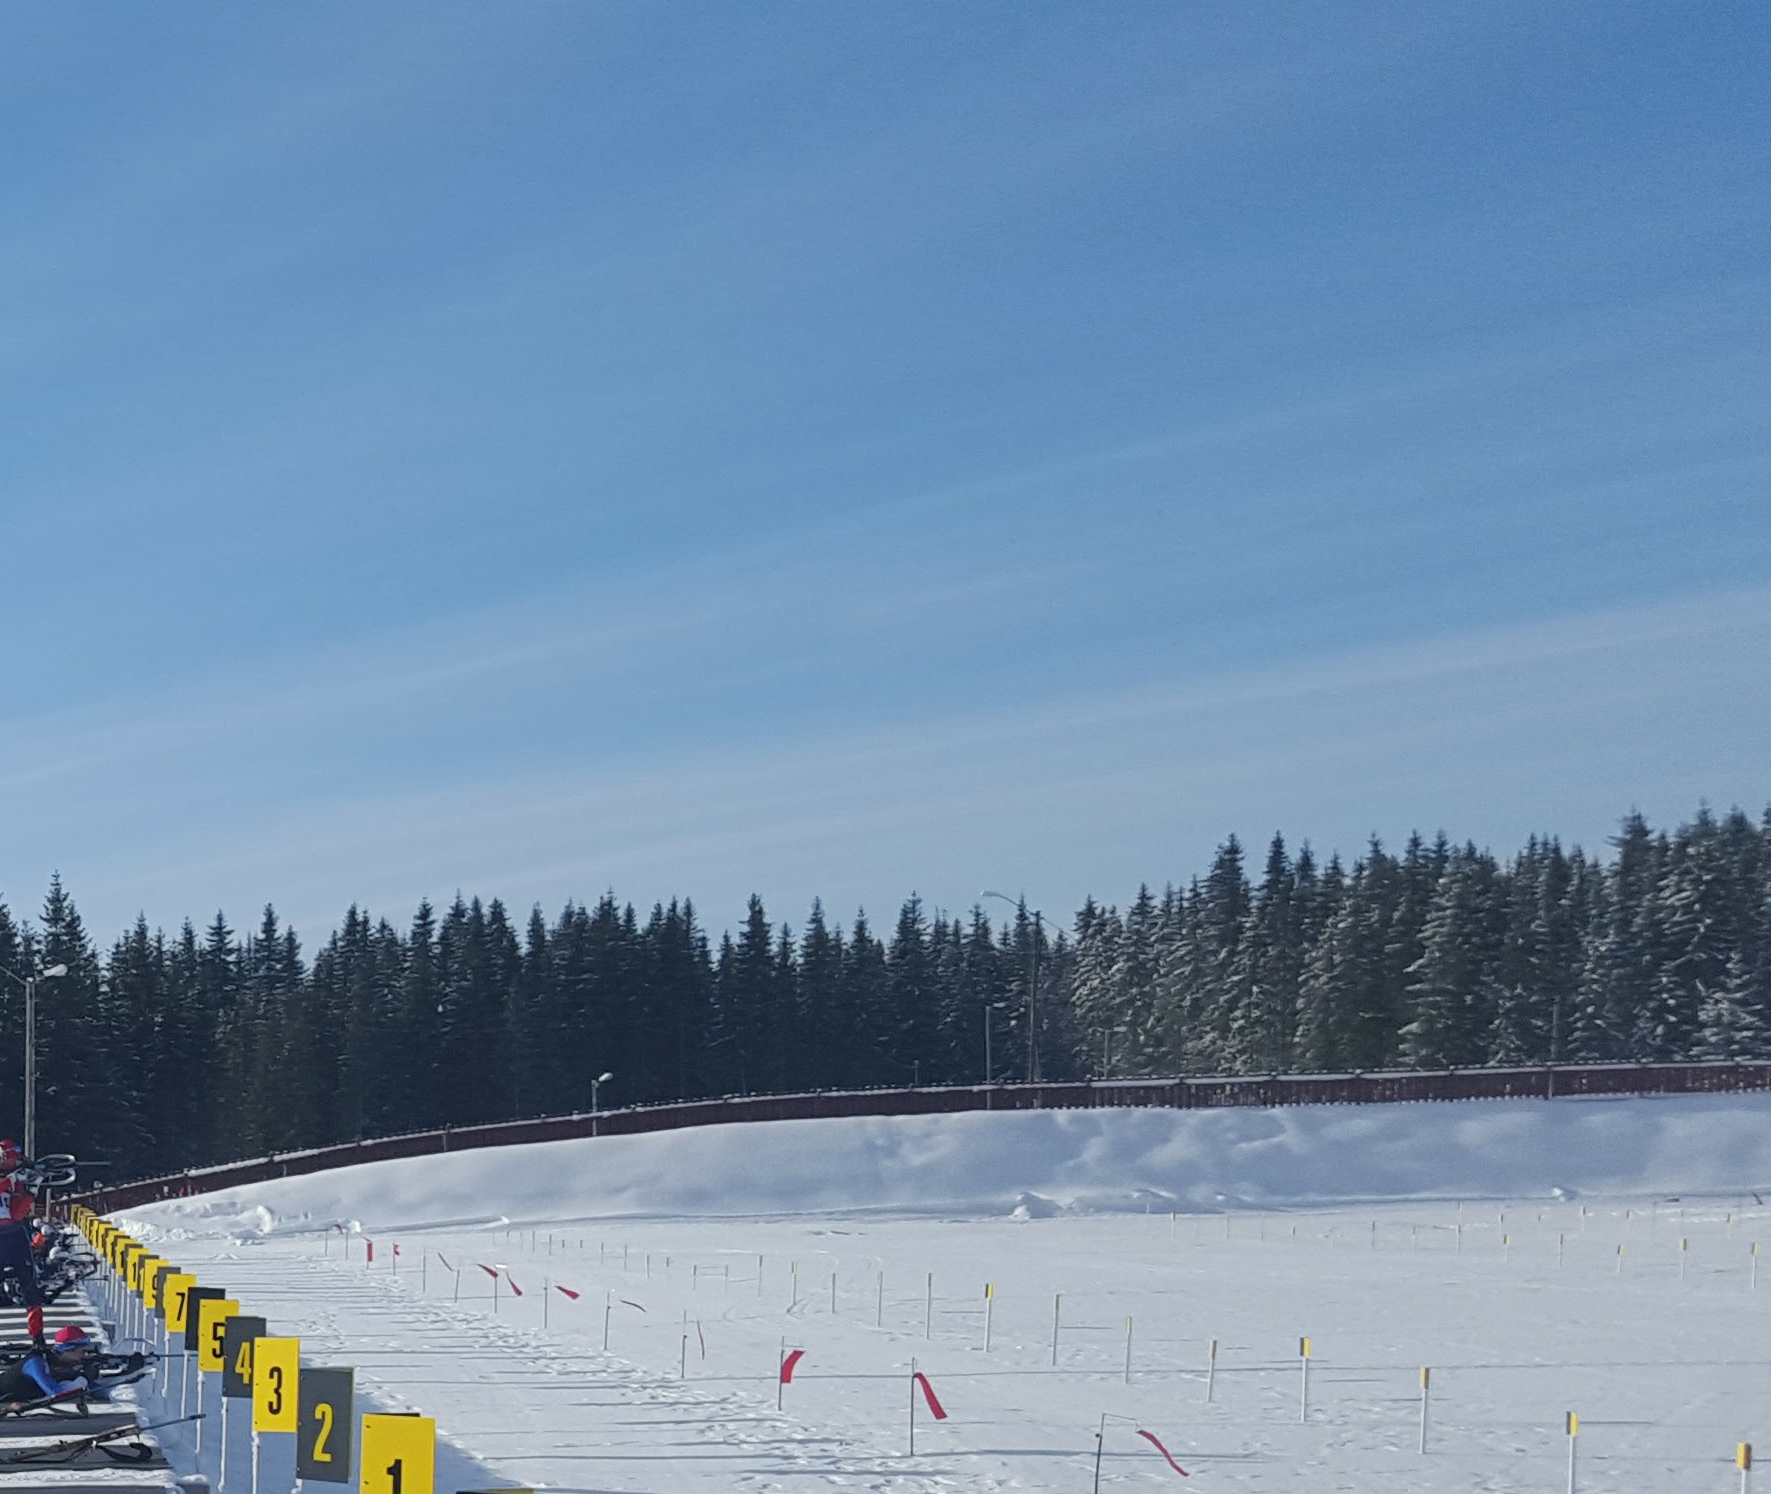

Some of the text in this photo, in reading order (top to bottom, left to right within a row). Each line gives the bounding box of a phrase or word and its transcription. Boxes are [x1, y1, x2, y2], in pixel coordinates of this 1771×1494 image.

[175, 1292, 186, 1322] 7
[212, 1321, 225, 1359] 5
[234, 1341, 252, 1385] 4
[267, 1366, 283, 1415] 3
[313, 1402, 334, 1462] 2
